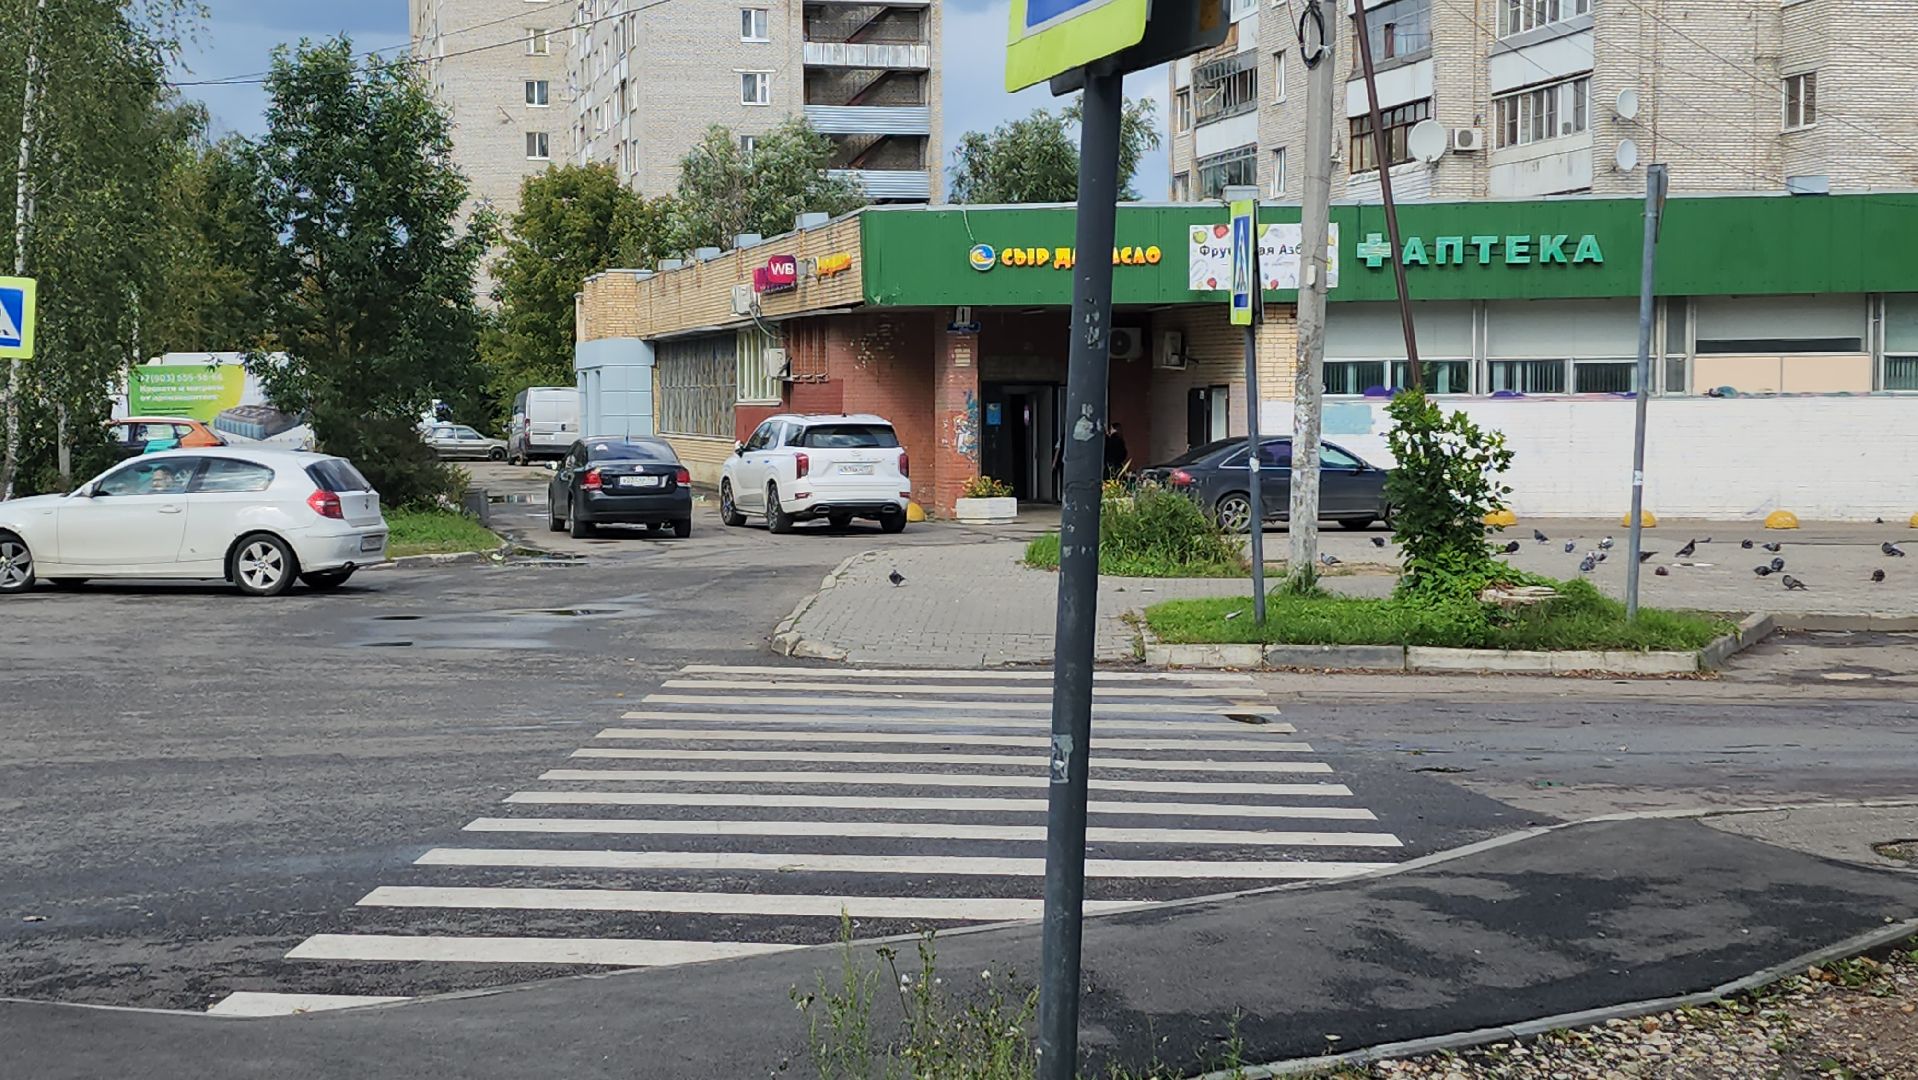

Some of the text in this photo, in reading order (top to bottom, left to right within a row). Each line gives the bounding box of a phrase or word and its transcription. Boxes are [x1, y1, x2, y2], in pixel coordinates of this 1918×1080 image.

[1001, 245, 1162, 269] СЫР Д АСЛО
[1402, 234, 1604, 265] АПТЕКА
[770, 262, 795, 275] WB
